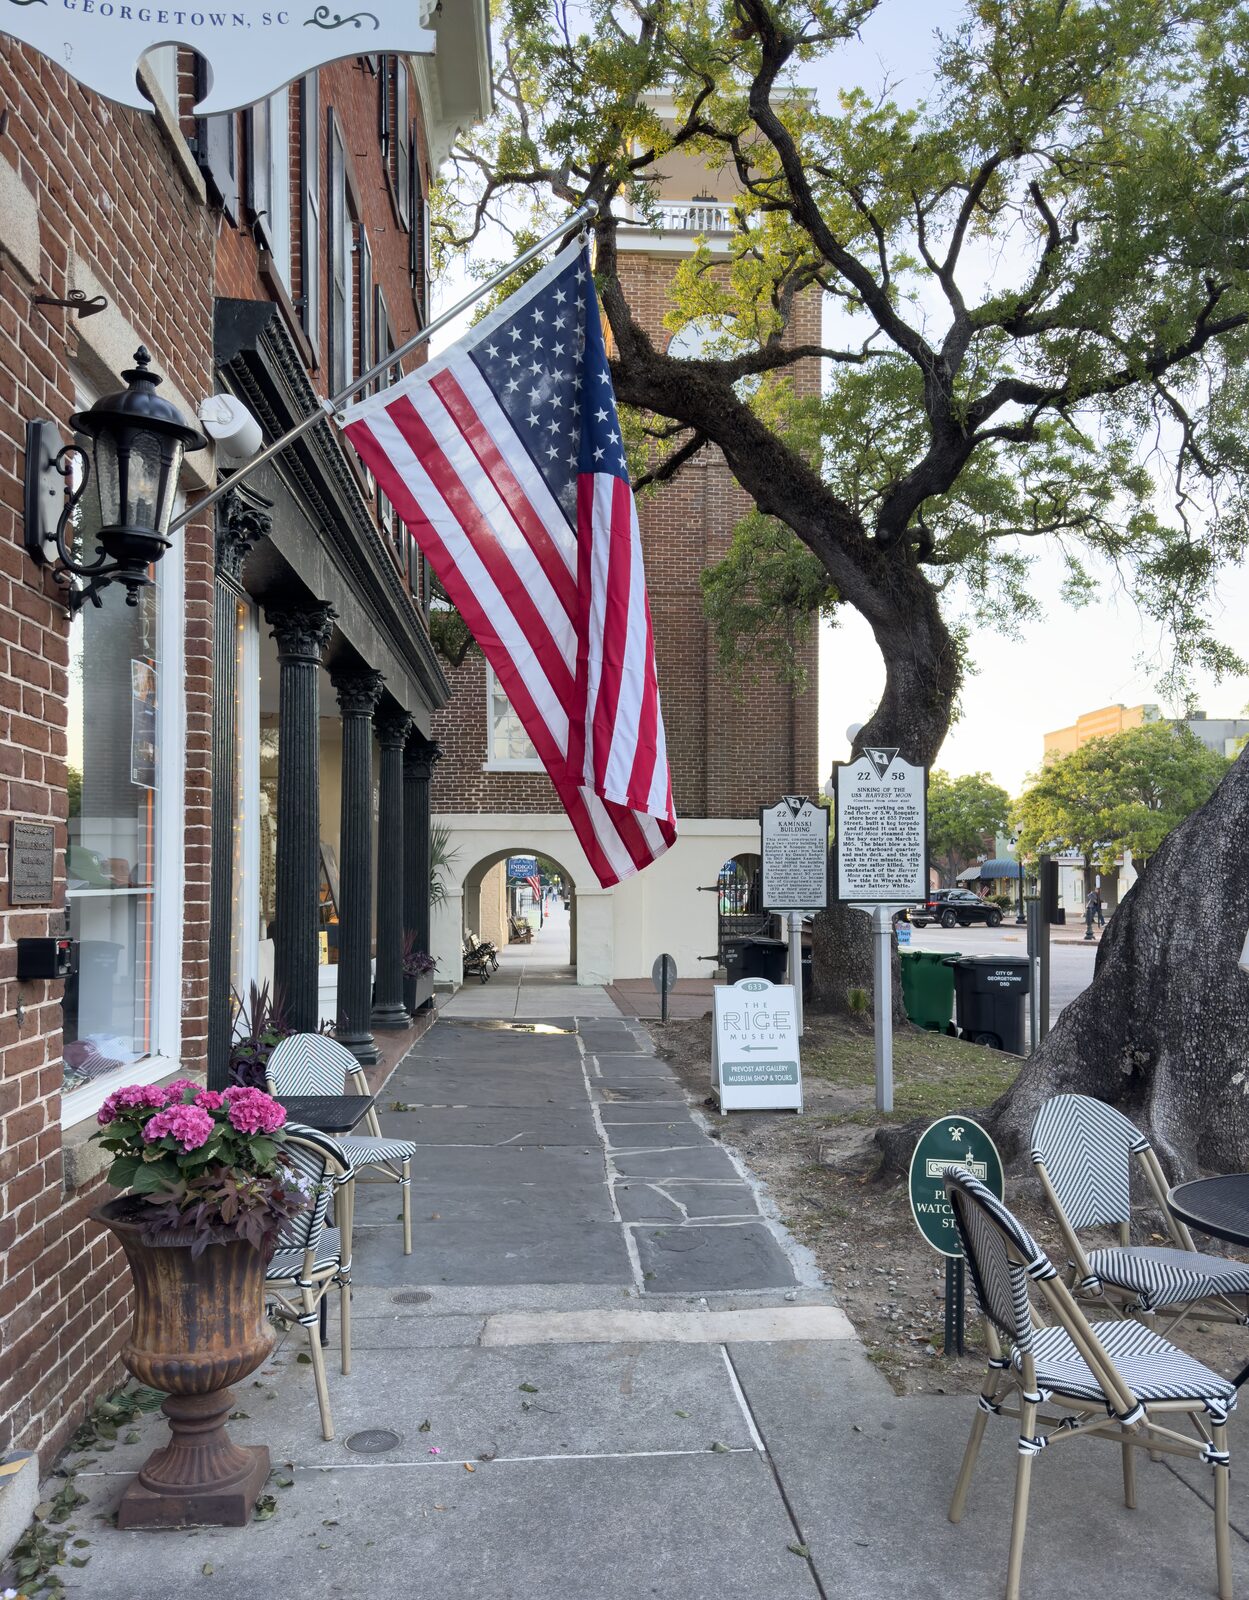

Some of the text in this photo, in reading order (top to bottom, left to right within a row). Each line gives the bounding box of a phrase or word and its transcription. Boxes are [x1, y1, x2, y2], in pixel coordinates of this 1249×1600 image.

[63, 0, 290, 28] GEORGETOWN, SC
[857, 772, 905, 780] 22 58
[723, 1011, 791, 1030] RICE
[916, 1203, 954, 1214] WATC
